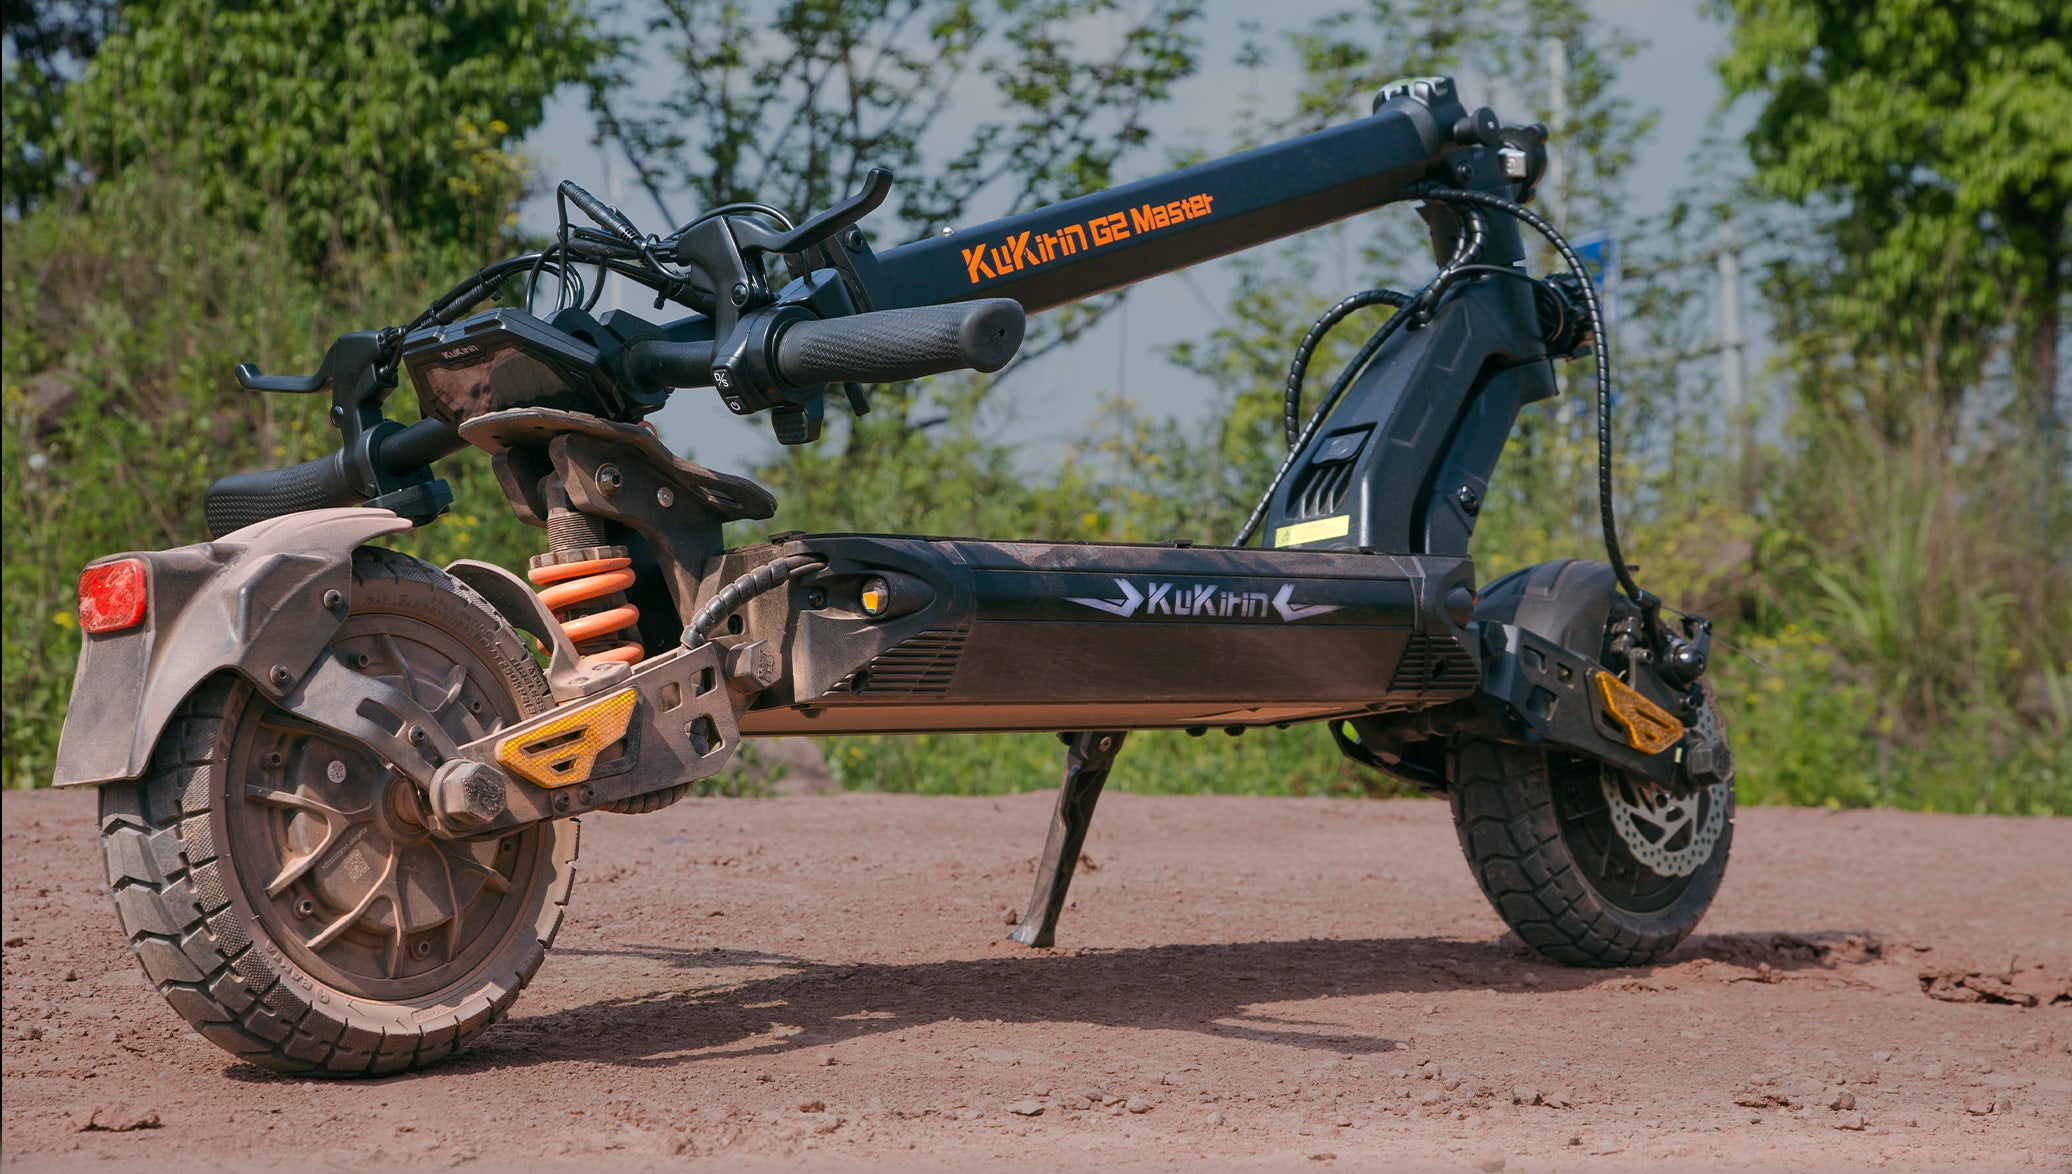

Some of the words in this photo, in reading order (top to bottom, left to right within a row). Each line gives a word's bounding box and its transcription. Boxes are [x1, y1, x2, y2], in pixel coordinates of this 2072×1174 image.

[961, 230, 1089, 284] KuKirin
[1088, 211, 1131, 247] G2
[1129, 193, 1214, 234] Master
[441, 344, 479, 360] KuKirin
[713, 372, 729, 388] D/S
[1147, 582, 1269, 618] KuKirin
